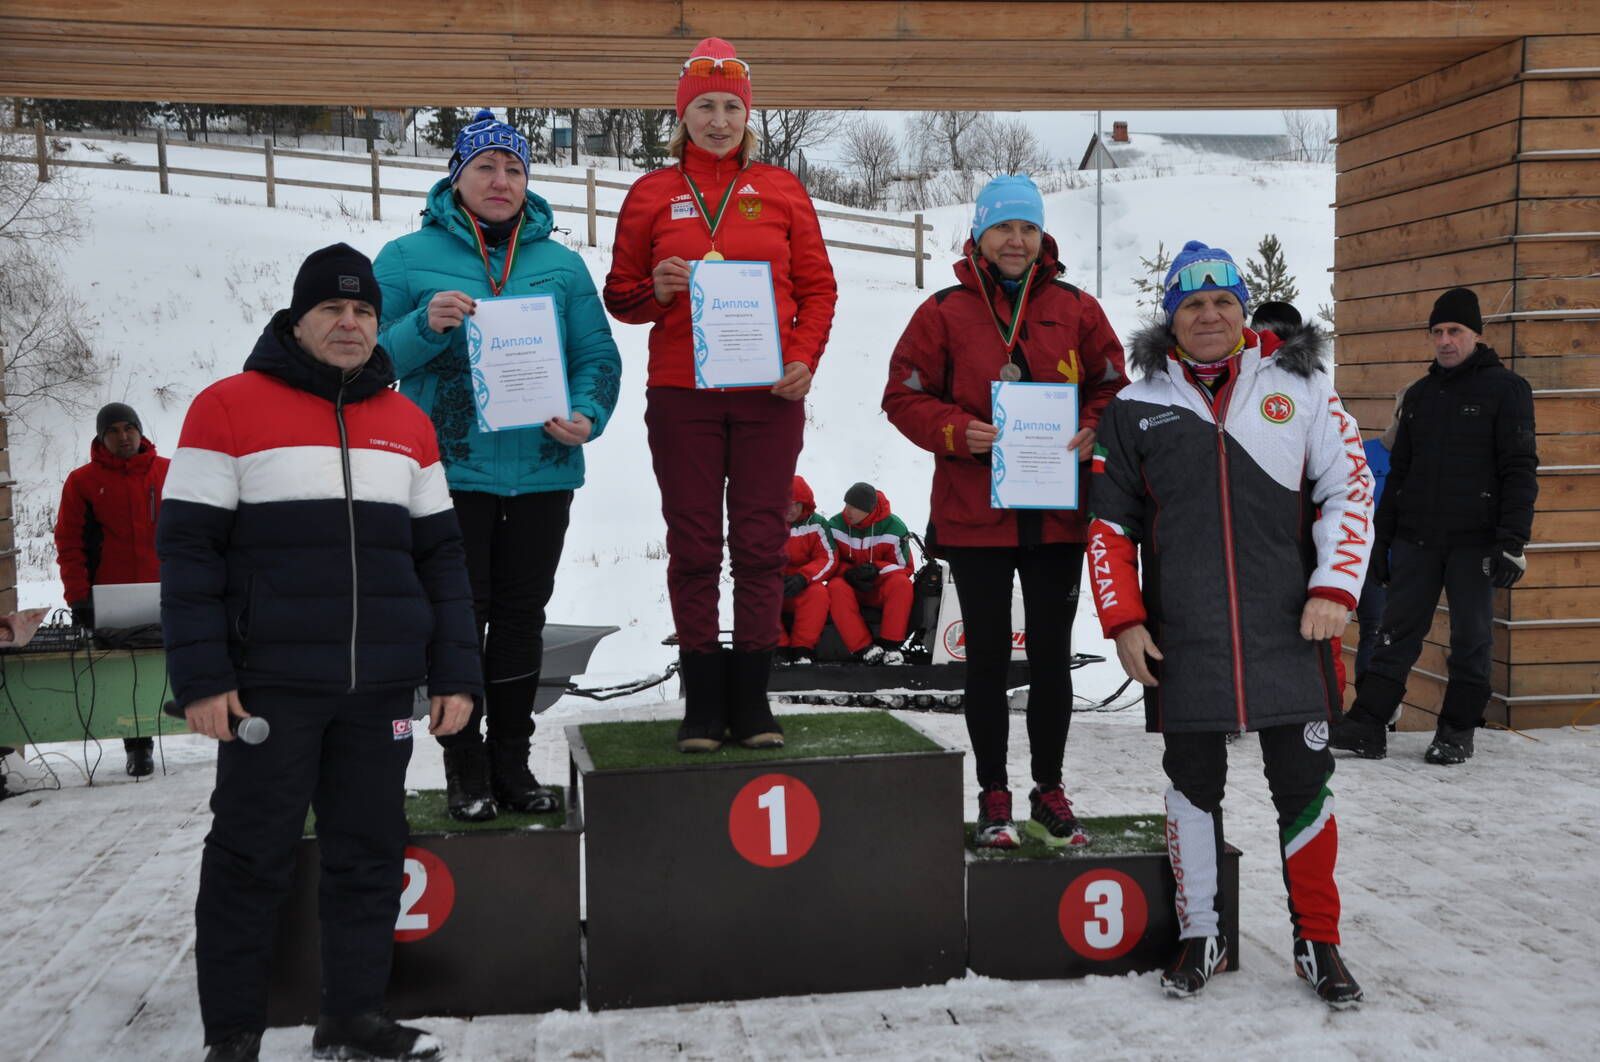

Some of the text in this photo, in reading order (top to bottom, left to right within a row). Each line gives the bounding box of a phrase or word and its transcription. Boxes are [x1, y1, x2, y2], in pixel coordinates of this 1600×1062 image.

[712, 298, 759, 310] Диплом
[490, 335, 544, 350] Диплом
[1013, 419, 1062, 432] Диплом
[1090, 533, 1119, 609] KAZAN
[758, 785, 788, 856] 1
[395, 858, 429, 930] 2
[1083, 879, 1124, 949] 3
